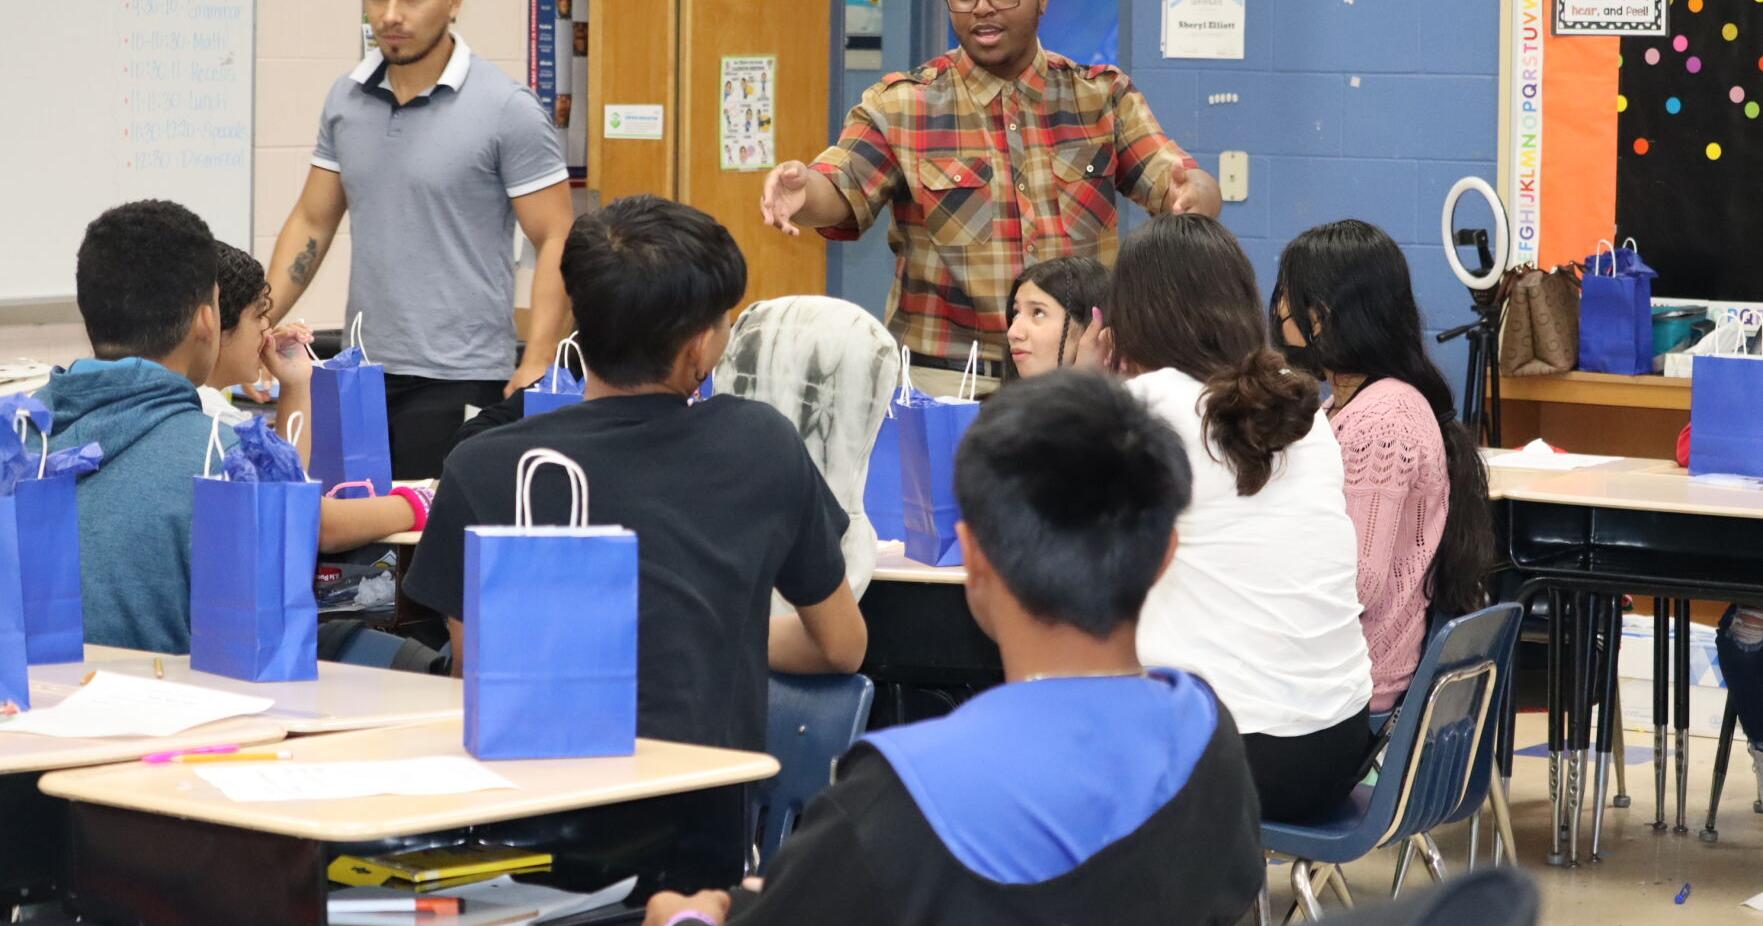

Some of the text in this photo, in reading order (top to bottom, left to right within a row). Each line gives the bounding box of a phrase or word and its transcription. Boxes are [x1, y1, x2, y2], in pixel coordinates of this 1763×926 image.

[1571, 6, 1600, 17] hear,
[1603, 6, 1623, 16] and
[1178, 21, 1236, 30] Sheryl Elliott
